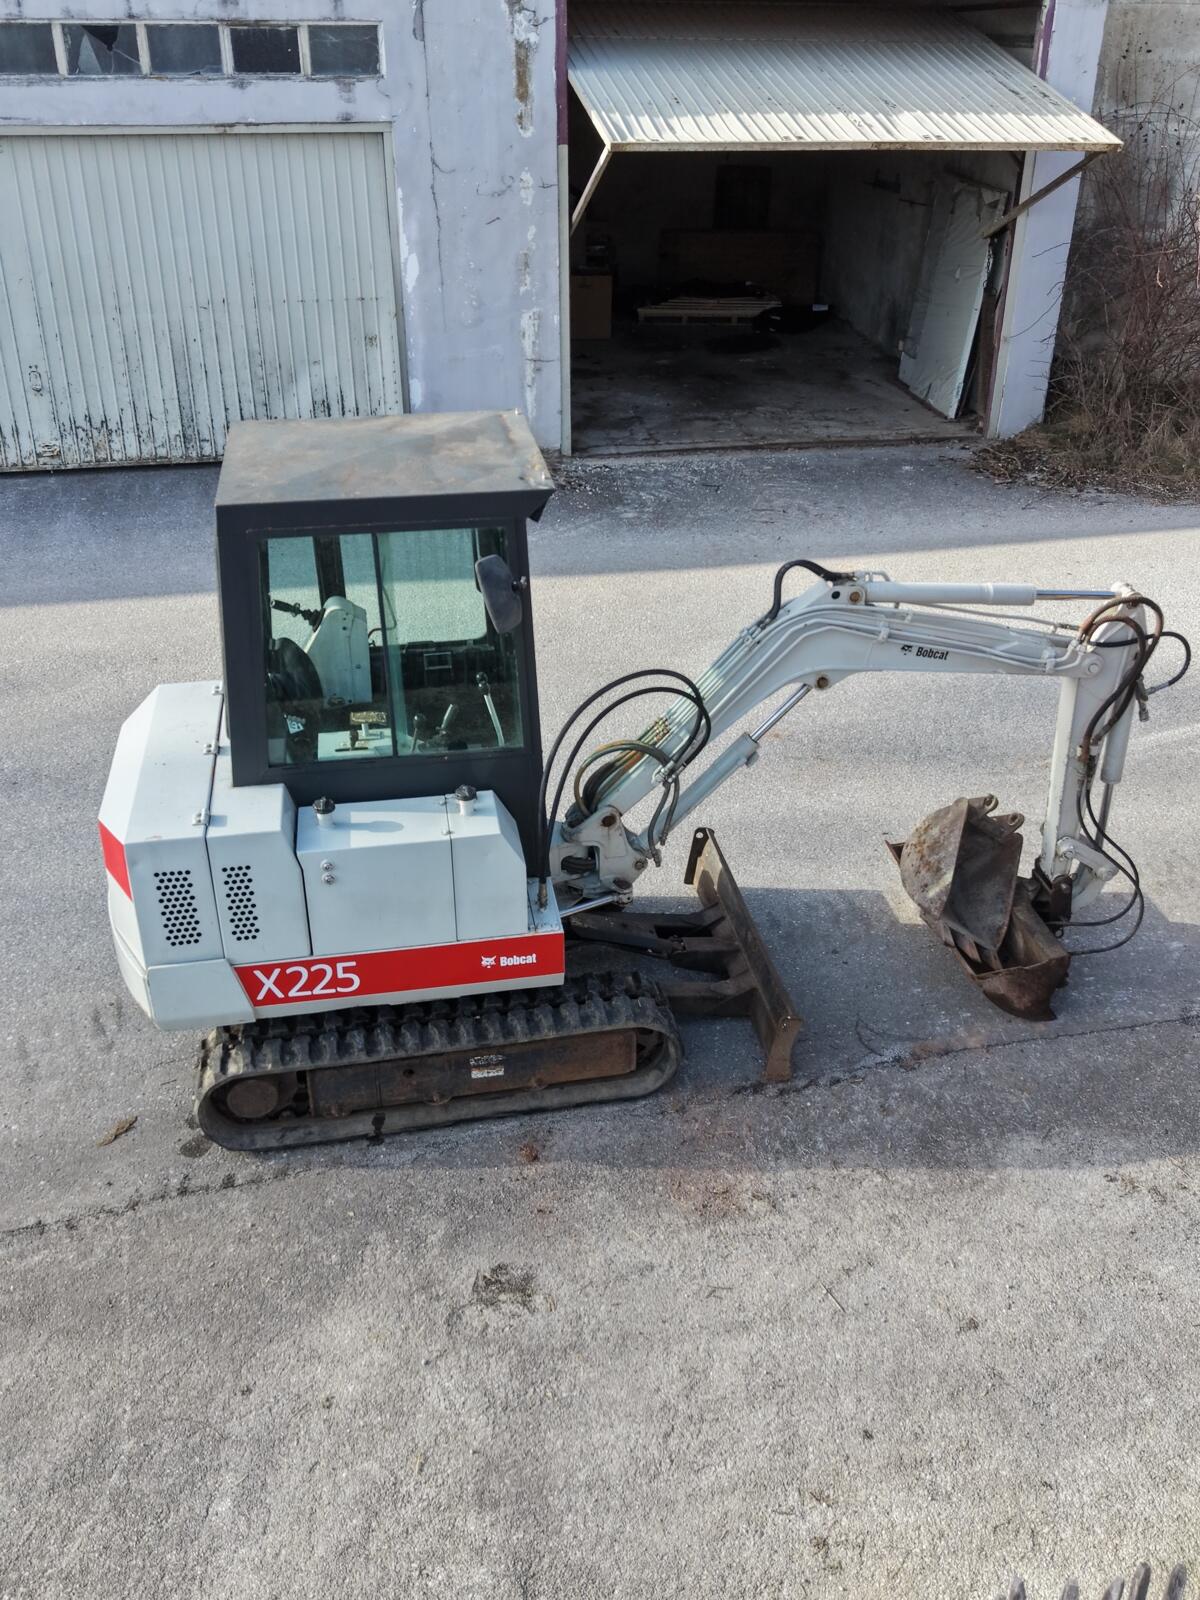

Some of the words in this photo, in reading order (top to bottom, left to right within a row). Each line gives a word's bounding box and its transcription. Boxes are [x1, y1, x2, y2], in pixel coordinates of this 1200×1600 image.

[916, 646, 949, 660] Bobcat
[500, 953, 537, 966] Bobcat
[253, 961, 361, 1000] X225
